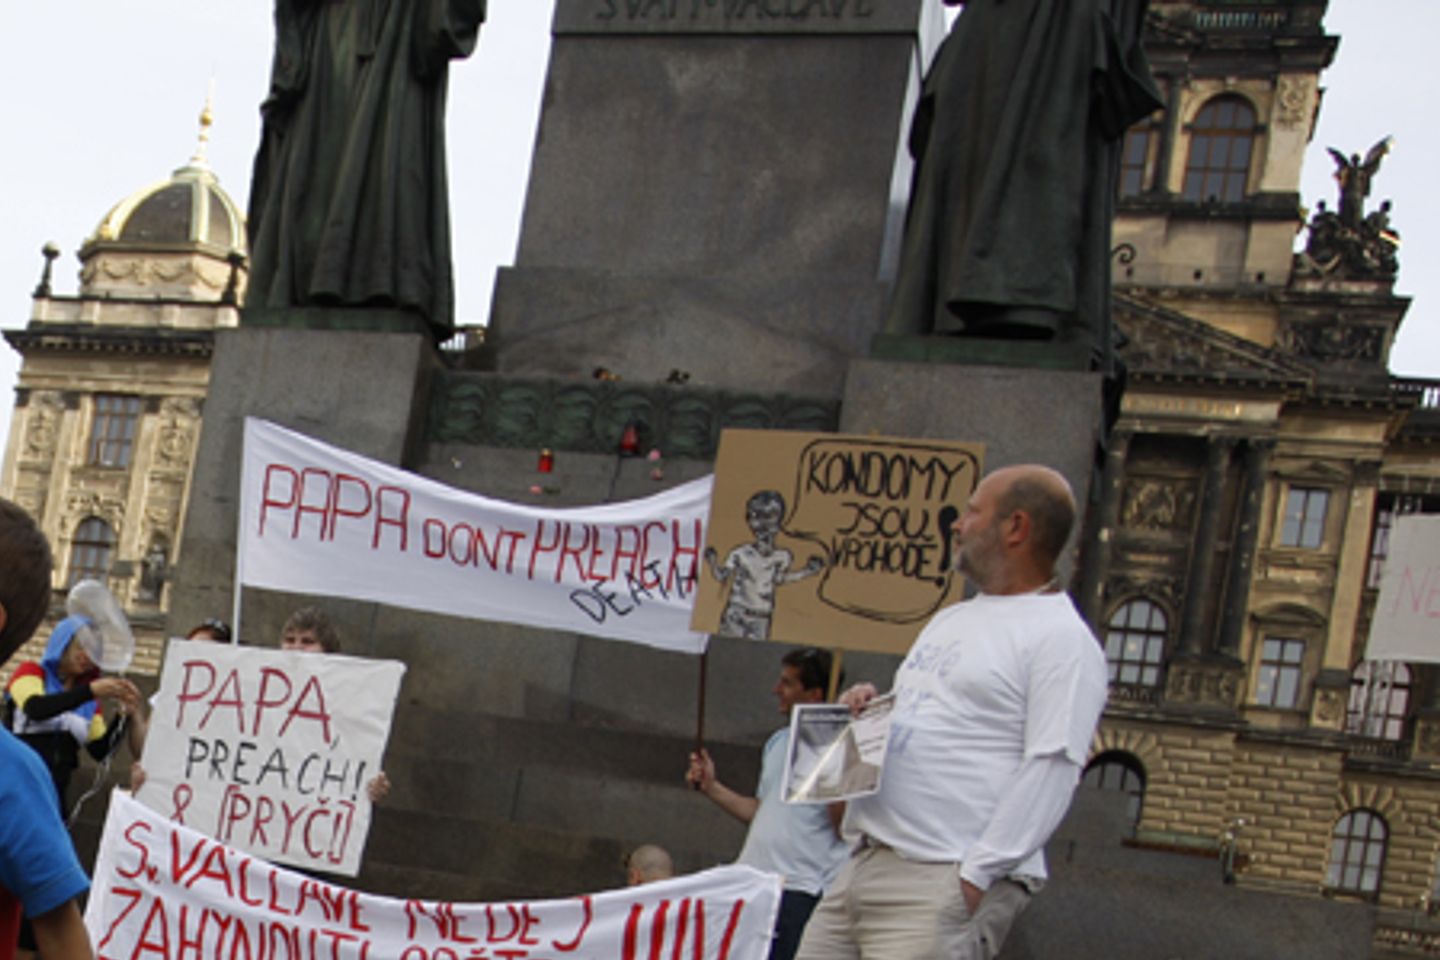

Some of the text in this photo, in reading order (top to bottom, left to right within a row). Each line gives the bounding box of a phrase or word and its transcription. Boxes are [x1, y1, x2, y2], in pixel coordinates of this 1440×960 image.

[805, 451, 967, 502] KONDOMY
[258, 463, 702, 594] PAPA DONT PREACH
[185, 736, 367, 801] PREACH!
